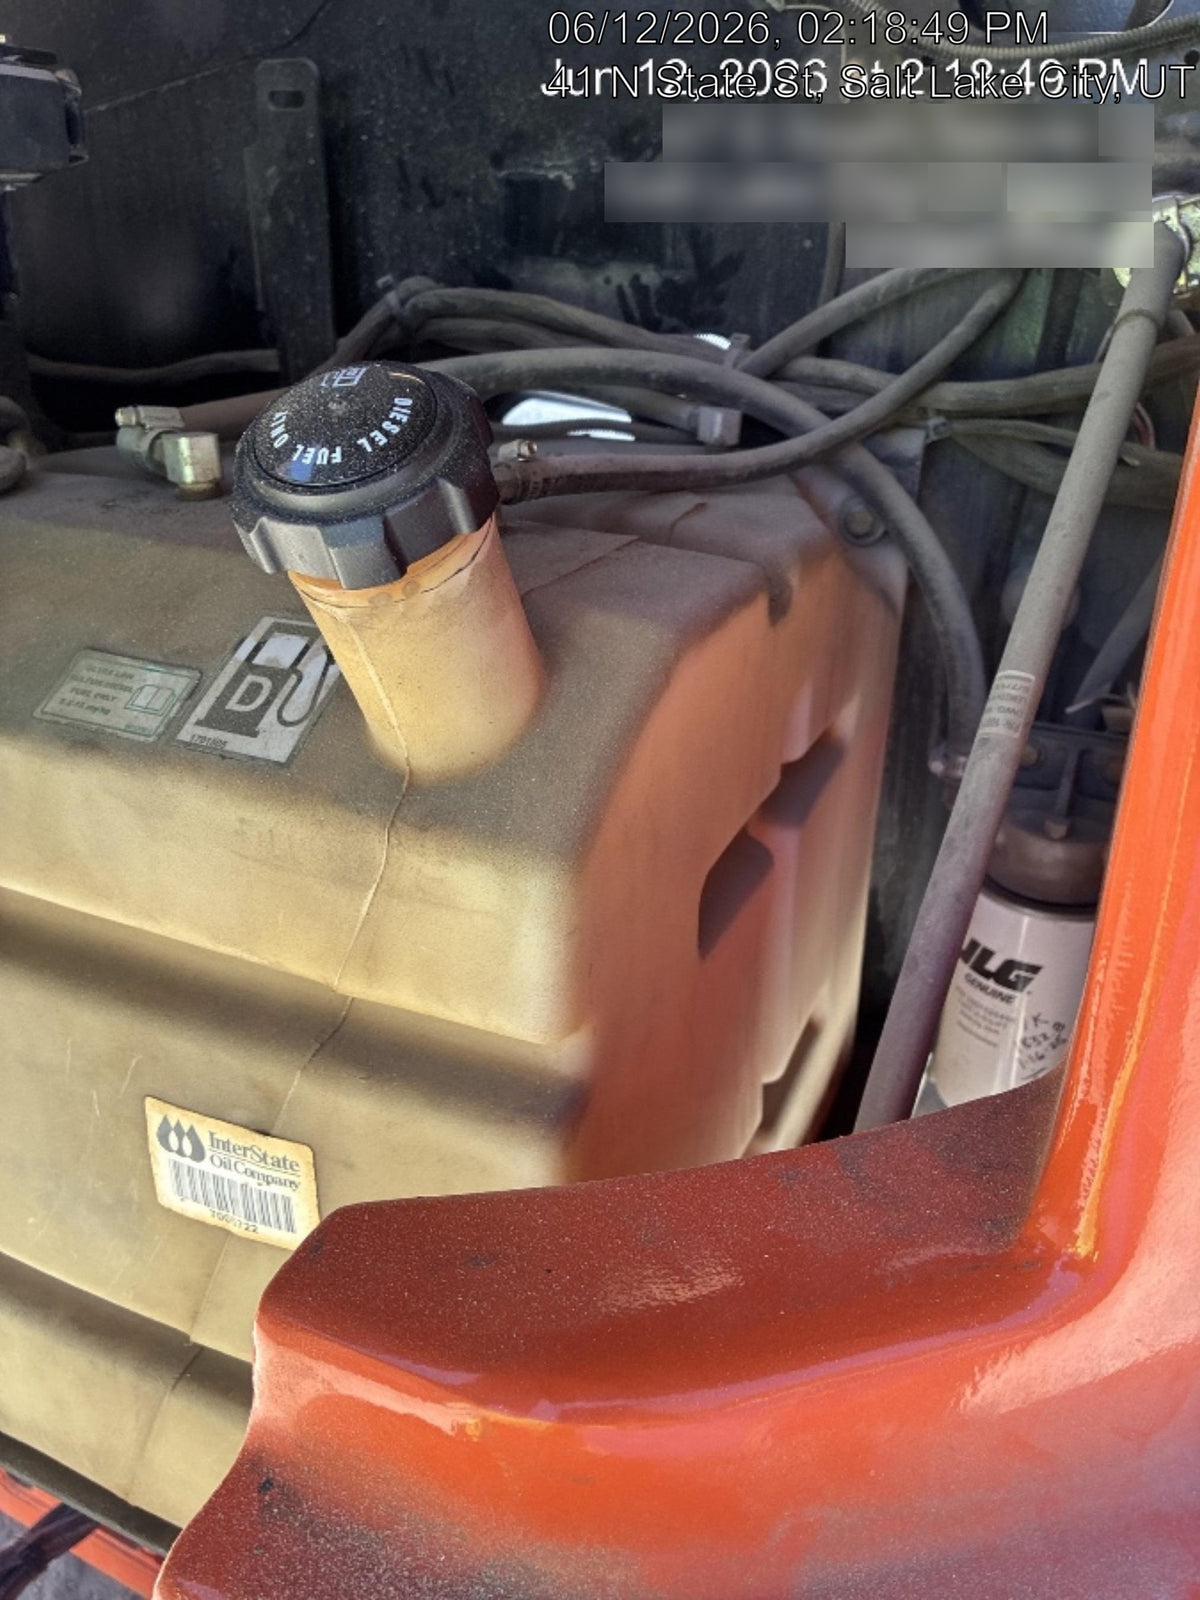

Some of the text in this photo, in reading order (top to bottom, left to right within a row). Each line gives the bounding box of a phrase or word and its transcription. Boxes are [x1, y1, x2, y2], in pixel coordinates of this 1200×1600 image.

[269, 397, 413, 466] DIESEL FUEL ONLY
[224, 674, 273, 714] D
[964, 972, 1017, 1005] GENUINE
[208, 1130, 301, 1173] InterState
[209, 1152, 300, 1191] Oil Company
